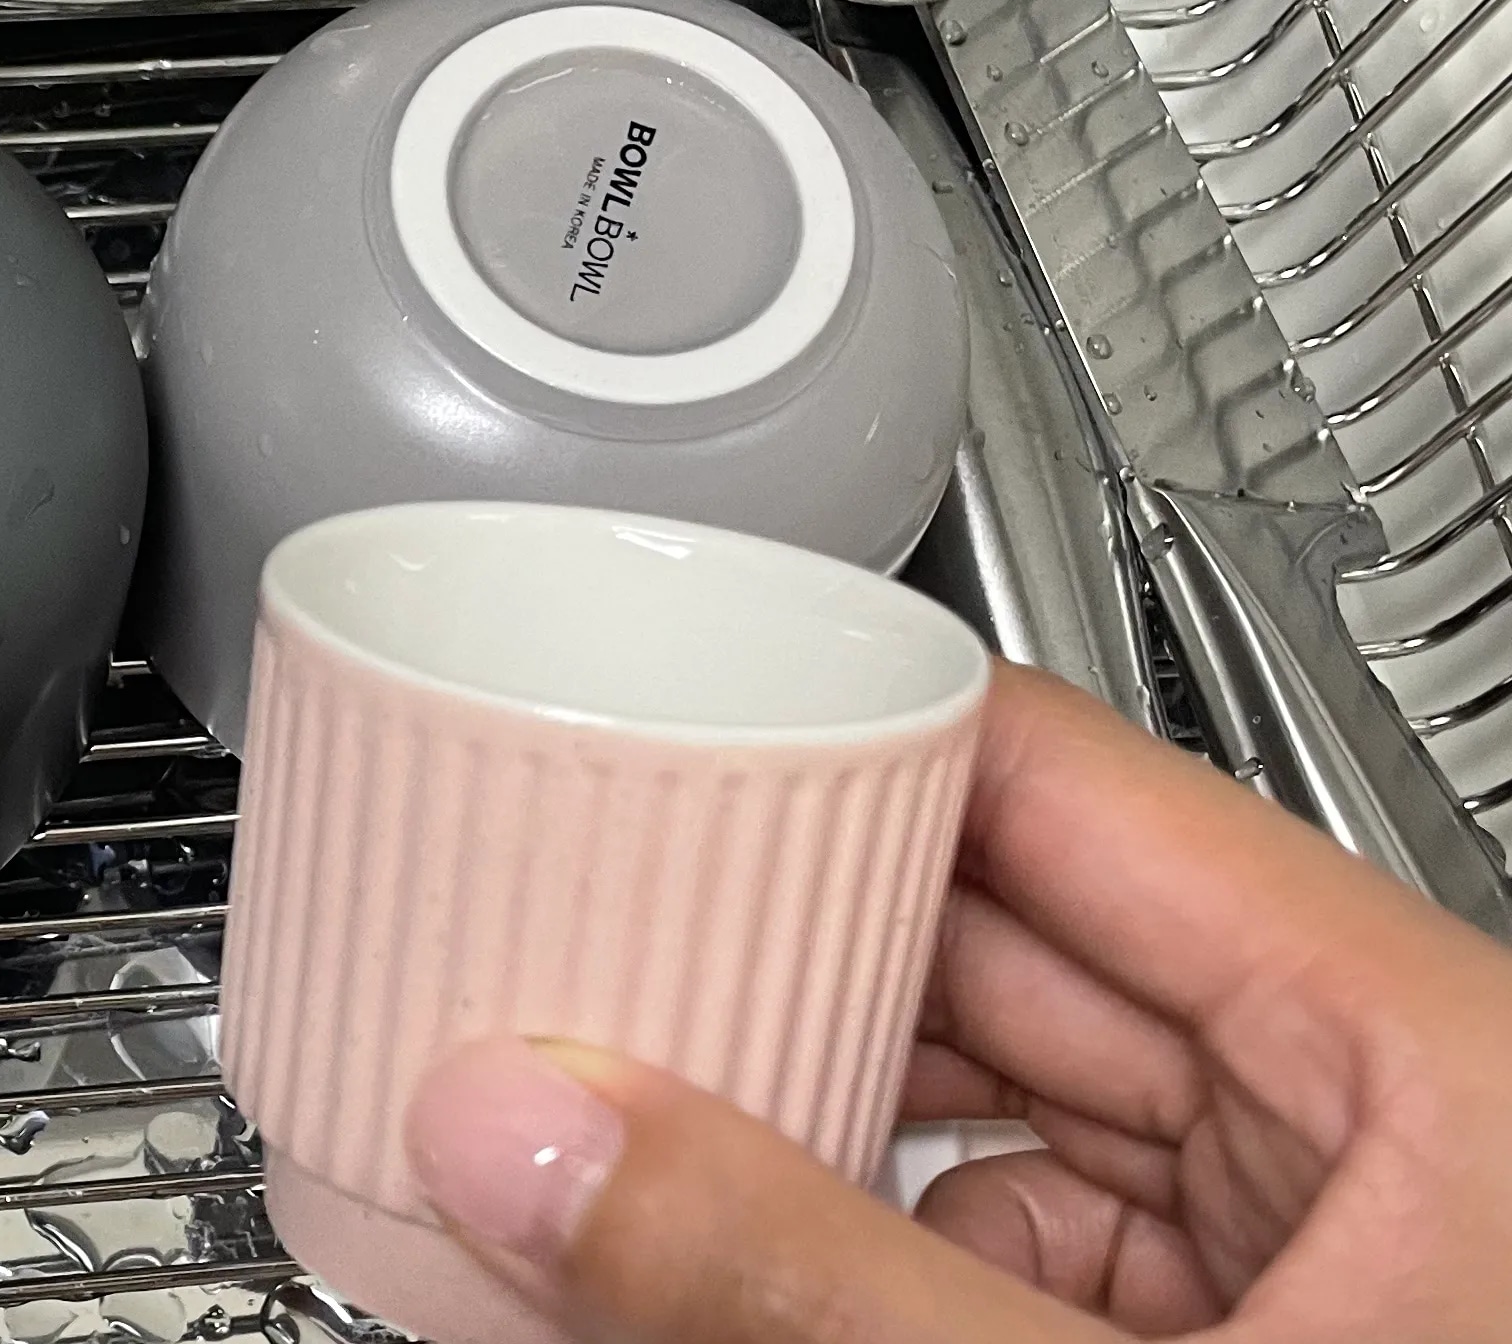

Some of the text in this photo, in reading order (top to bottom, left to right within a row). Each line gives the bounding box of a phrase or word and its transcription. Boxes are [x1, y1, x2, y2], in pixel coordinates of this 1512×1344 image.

[561, 157, 606, 249] MADE IN KOREA
